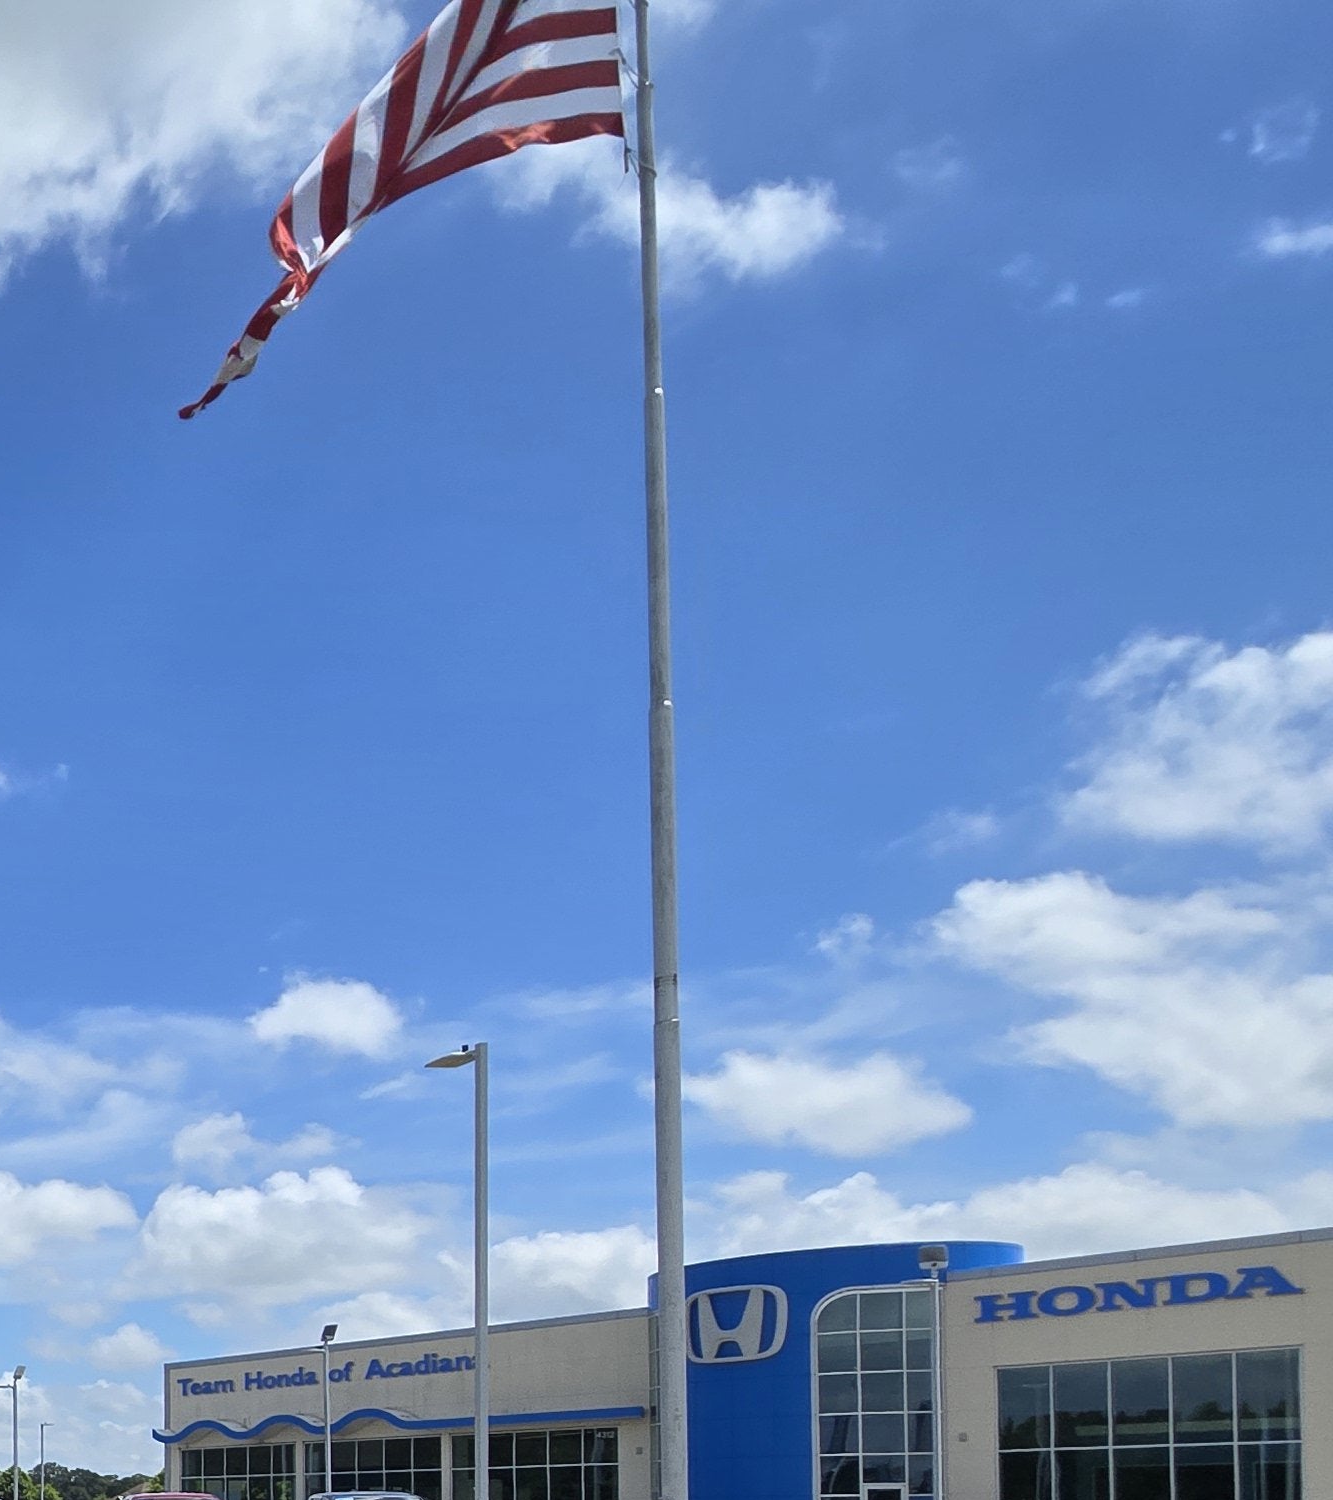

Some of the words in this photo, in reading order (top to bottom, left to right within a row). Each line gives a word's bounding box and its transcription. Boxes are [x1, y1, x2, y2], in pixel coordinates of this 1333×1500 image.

[973, 1265, 1306, 1324] HONDA
[177, 1377, 235, 1397] Team
[244, 1366, 320, 1391] Honda
[328, 1361, 355, 1382] of
